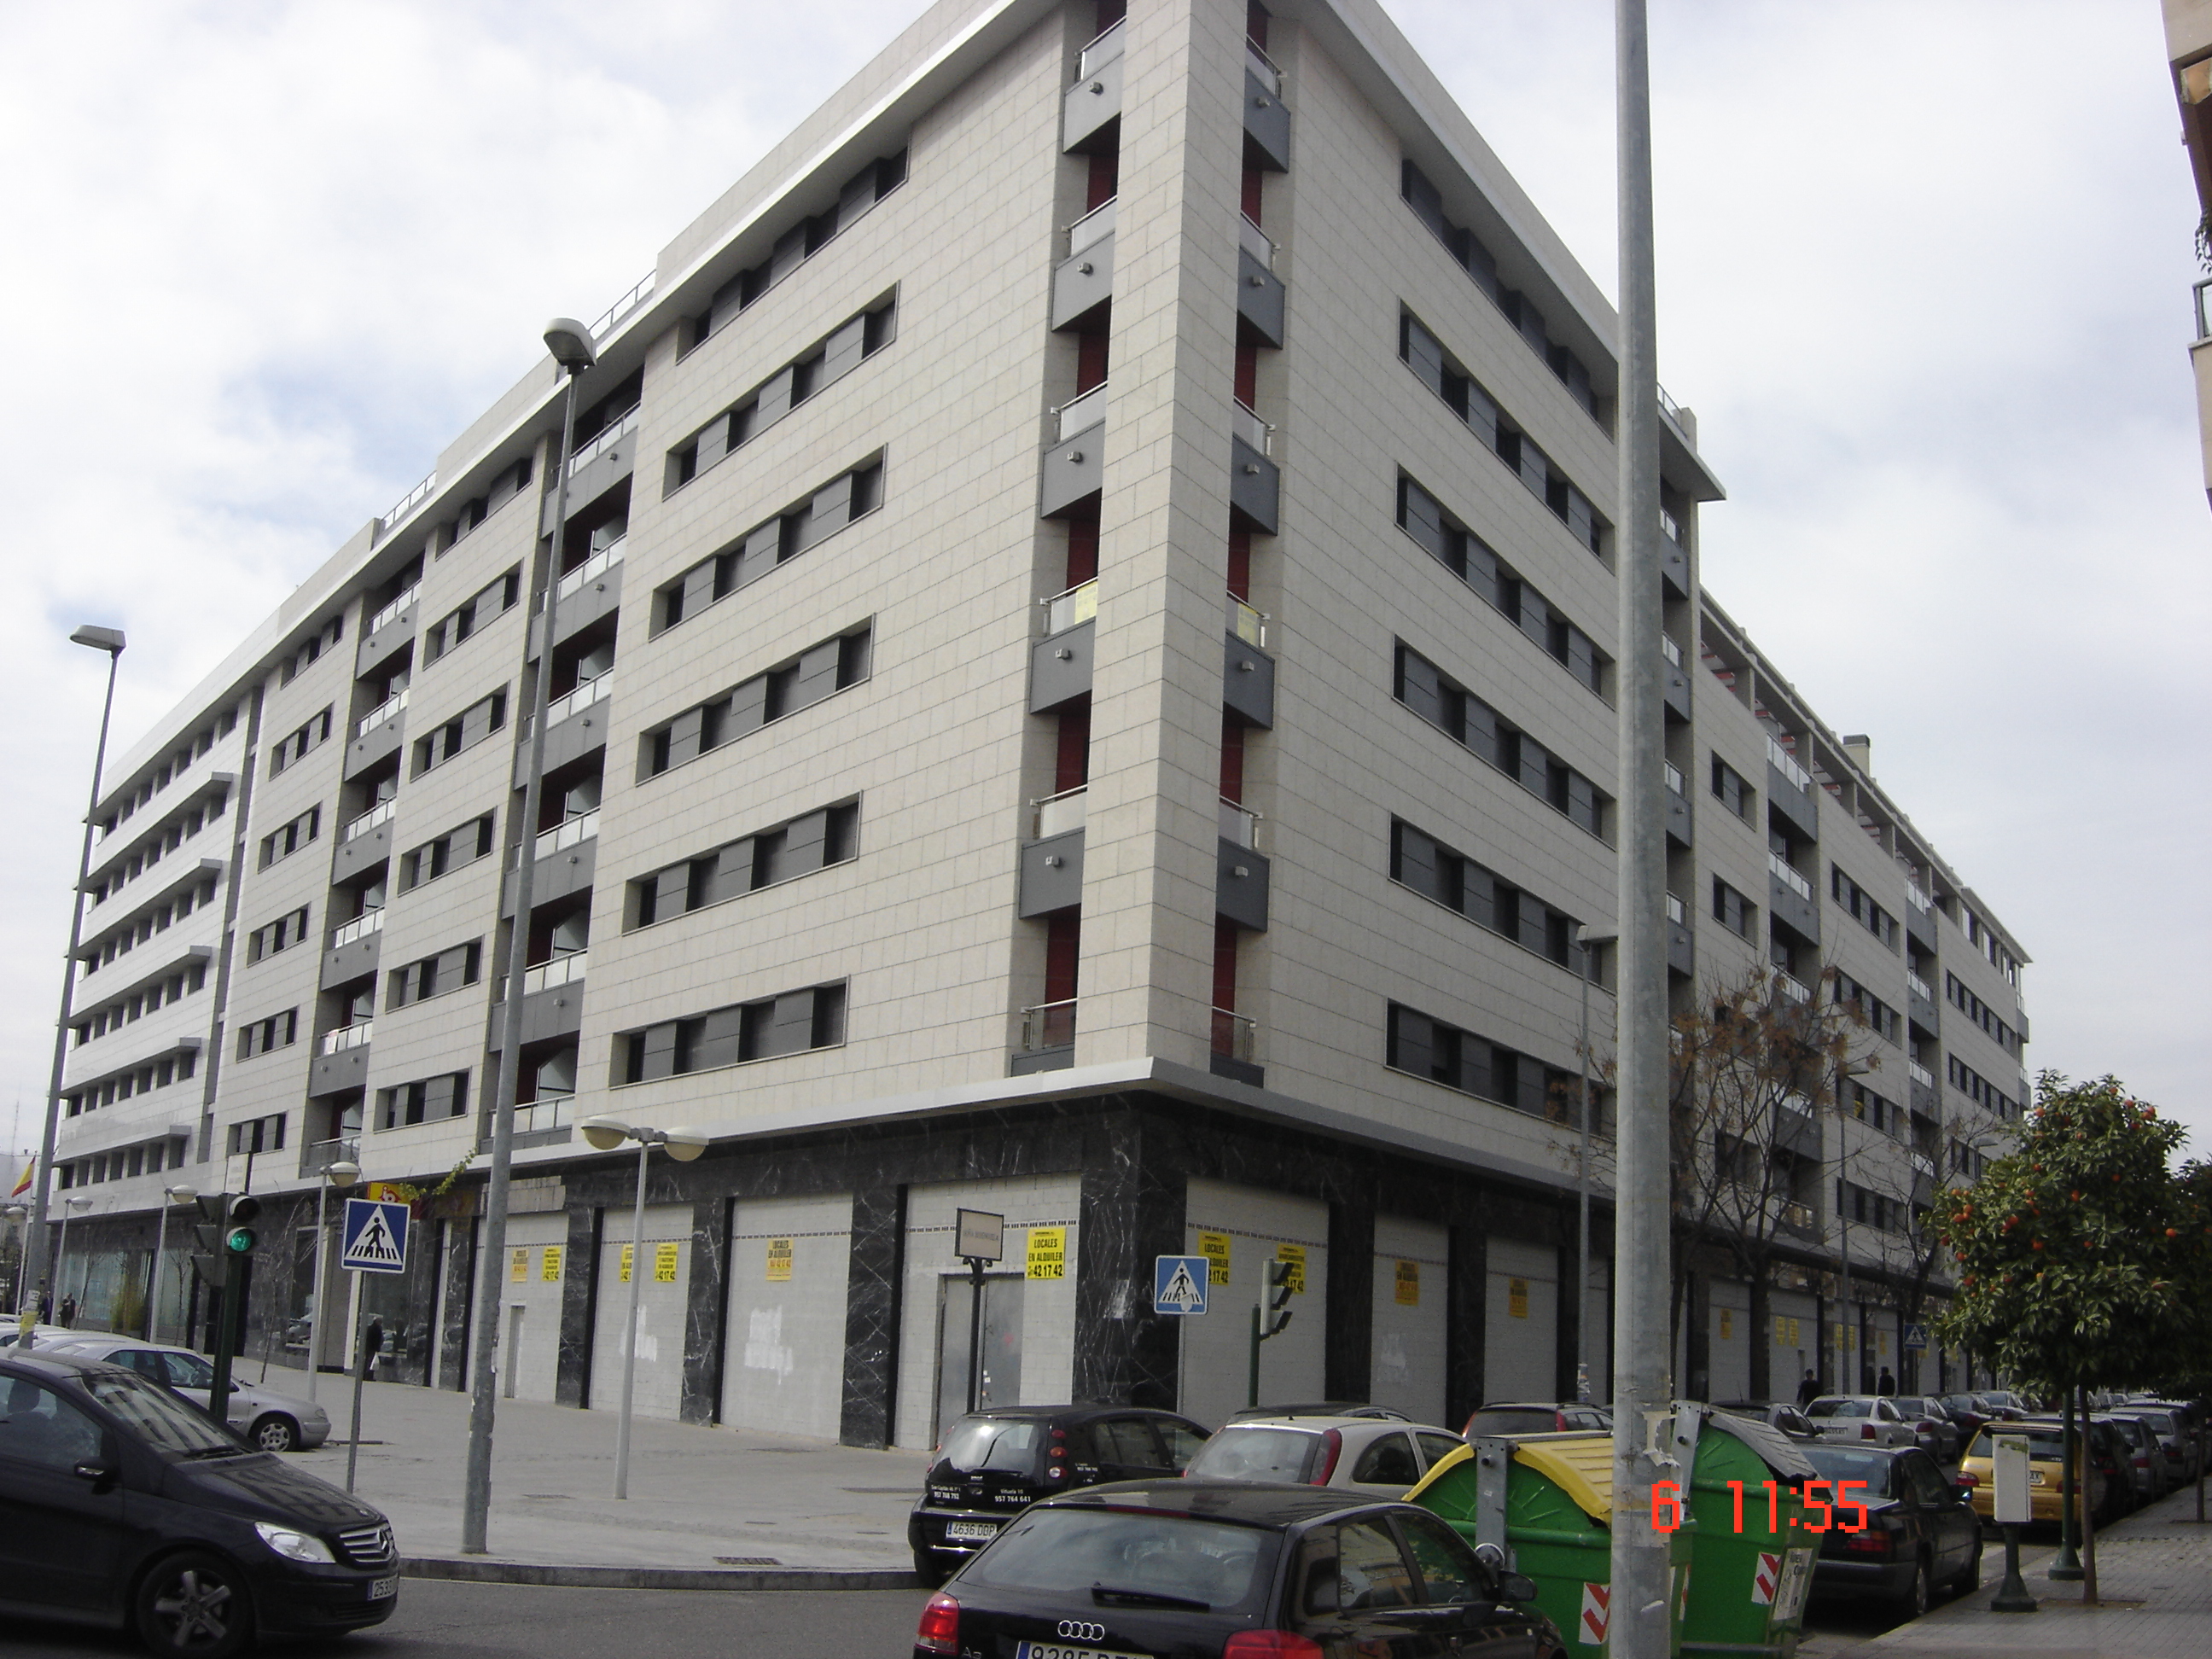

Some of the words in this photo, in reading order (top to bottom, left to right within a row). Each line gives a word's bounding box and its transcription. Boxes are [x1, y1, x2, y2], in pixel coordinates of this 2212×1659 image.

[1034, 1238, 1057, 1249] LOCALES
[1028, 1253, 1035, 1261] EN
[1037, 1252, 1062, 1262] ALQUILER
[1033, 1265, 1042, 1278] 42
[1044, 1265, 1051, 1278] 17
[1053, 1264, 1062, 1278] 42
[1213, 1270, 1220, 1283] 17
[953, 1522, 975, 1535] 4636
